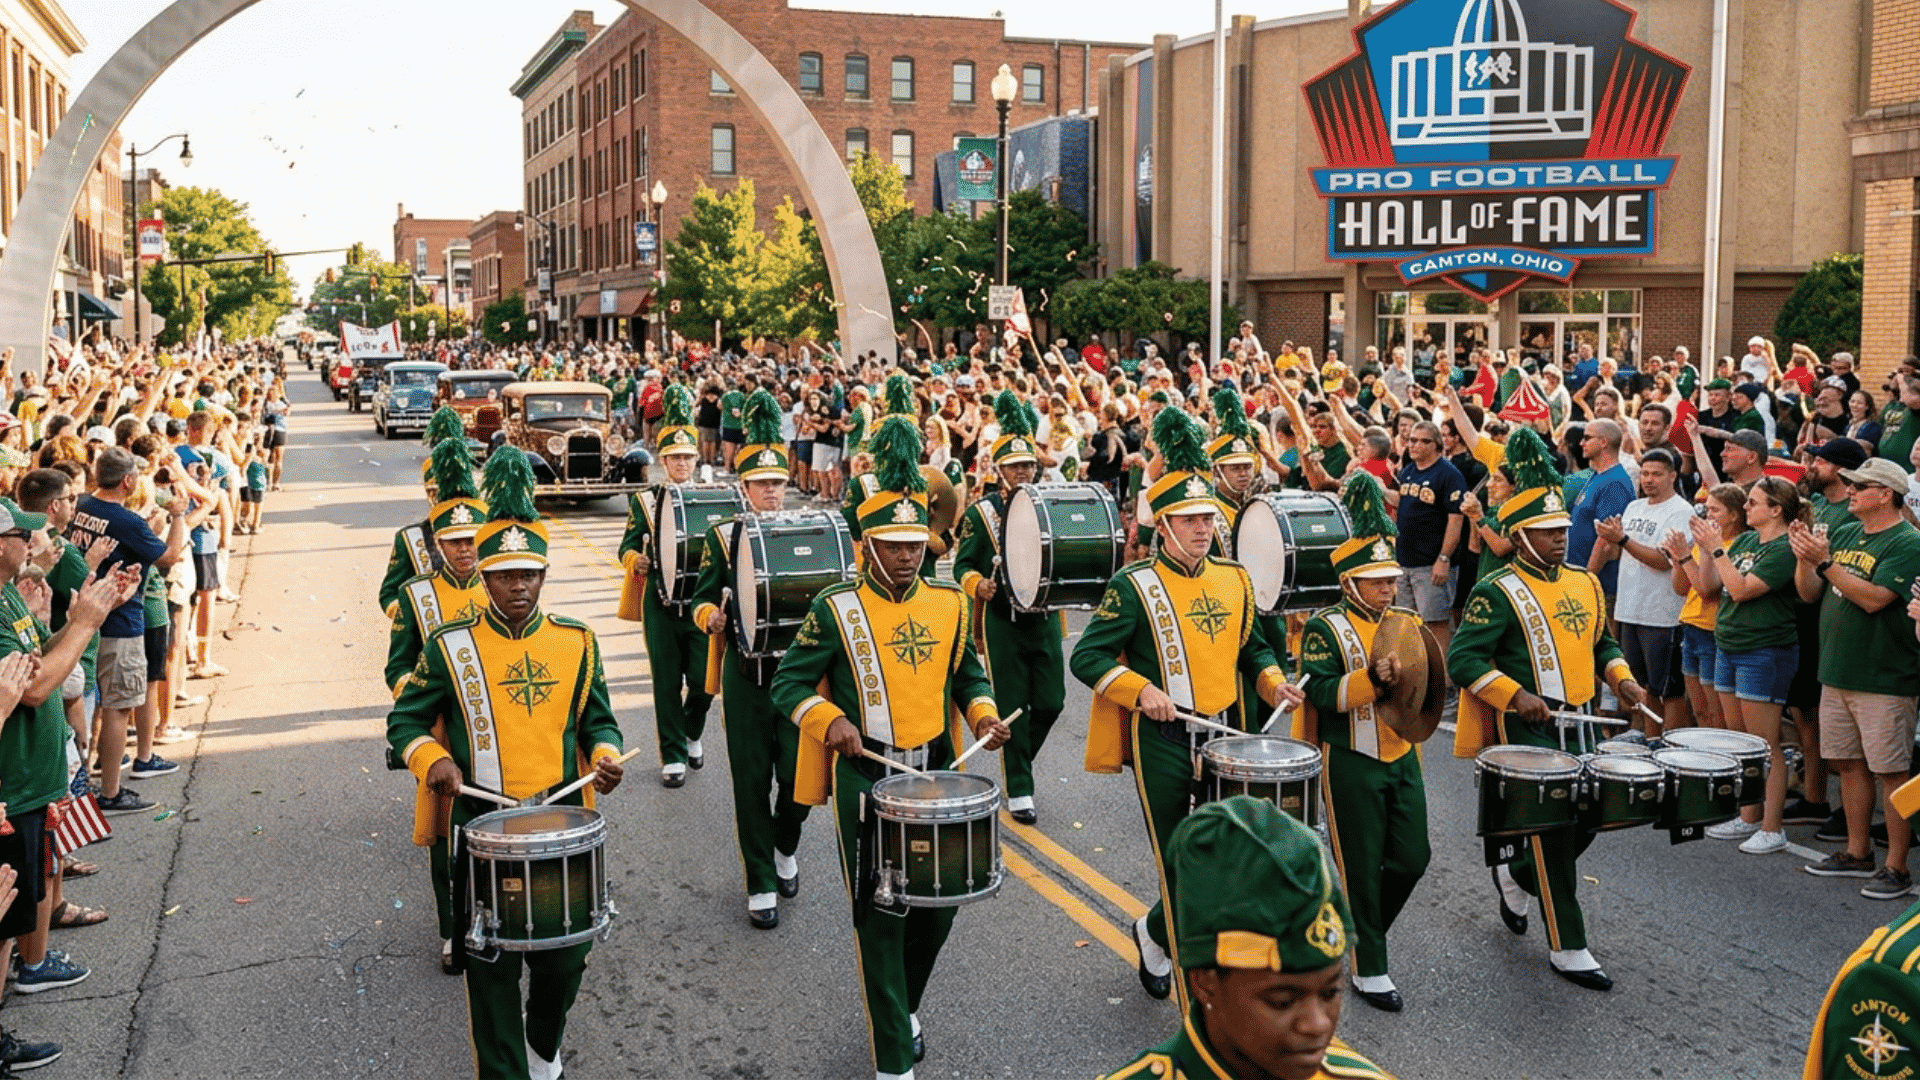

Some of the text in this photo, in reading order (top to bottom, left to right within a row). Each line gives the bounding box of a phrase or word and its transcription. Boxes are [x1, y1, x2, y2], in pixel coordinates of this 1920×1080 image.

[1329, 163, 1657, 191] PRO FOOTBALL
[1338, 194, 1642, 246] HALL OF FAME
[1511, 252, 1564, 272] OHIO
[1148, 585, 1184, 676] CANTON
[457, 647, 491, 751] CANTON
[1851, 999, 1911, 1025] CANTON
